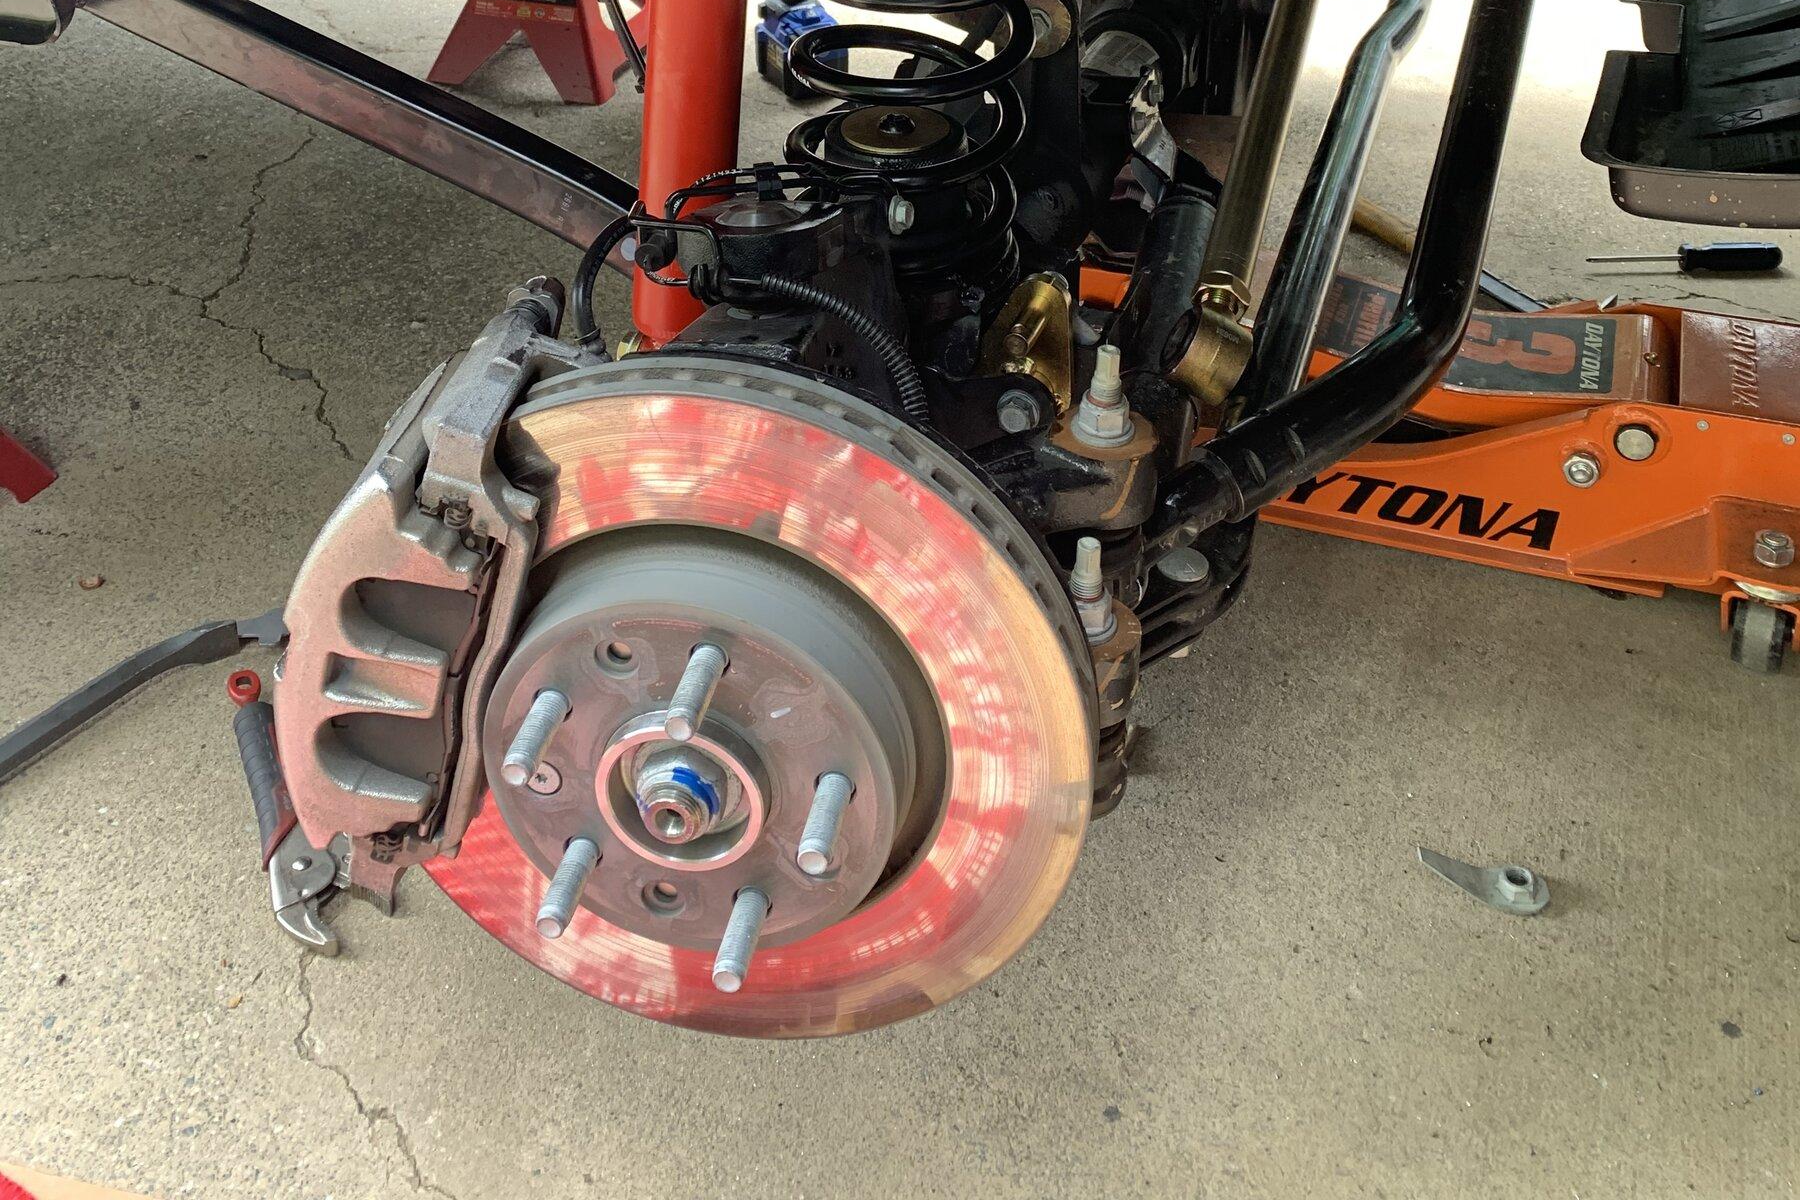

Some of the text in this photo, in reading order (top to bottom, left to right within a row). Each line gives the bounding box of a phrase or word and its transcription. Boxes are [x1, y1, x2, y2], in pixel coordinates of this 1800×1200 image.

[1579, 321, 1604, 391] DAYTONA
[1728, 320, 1760, 408] DAYTONA
[1284, 472, 1561, 551] YTONA
